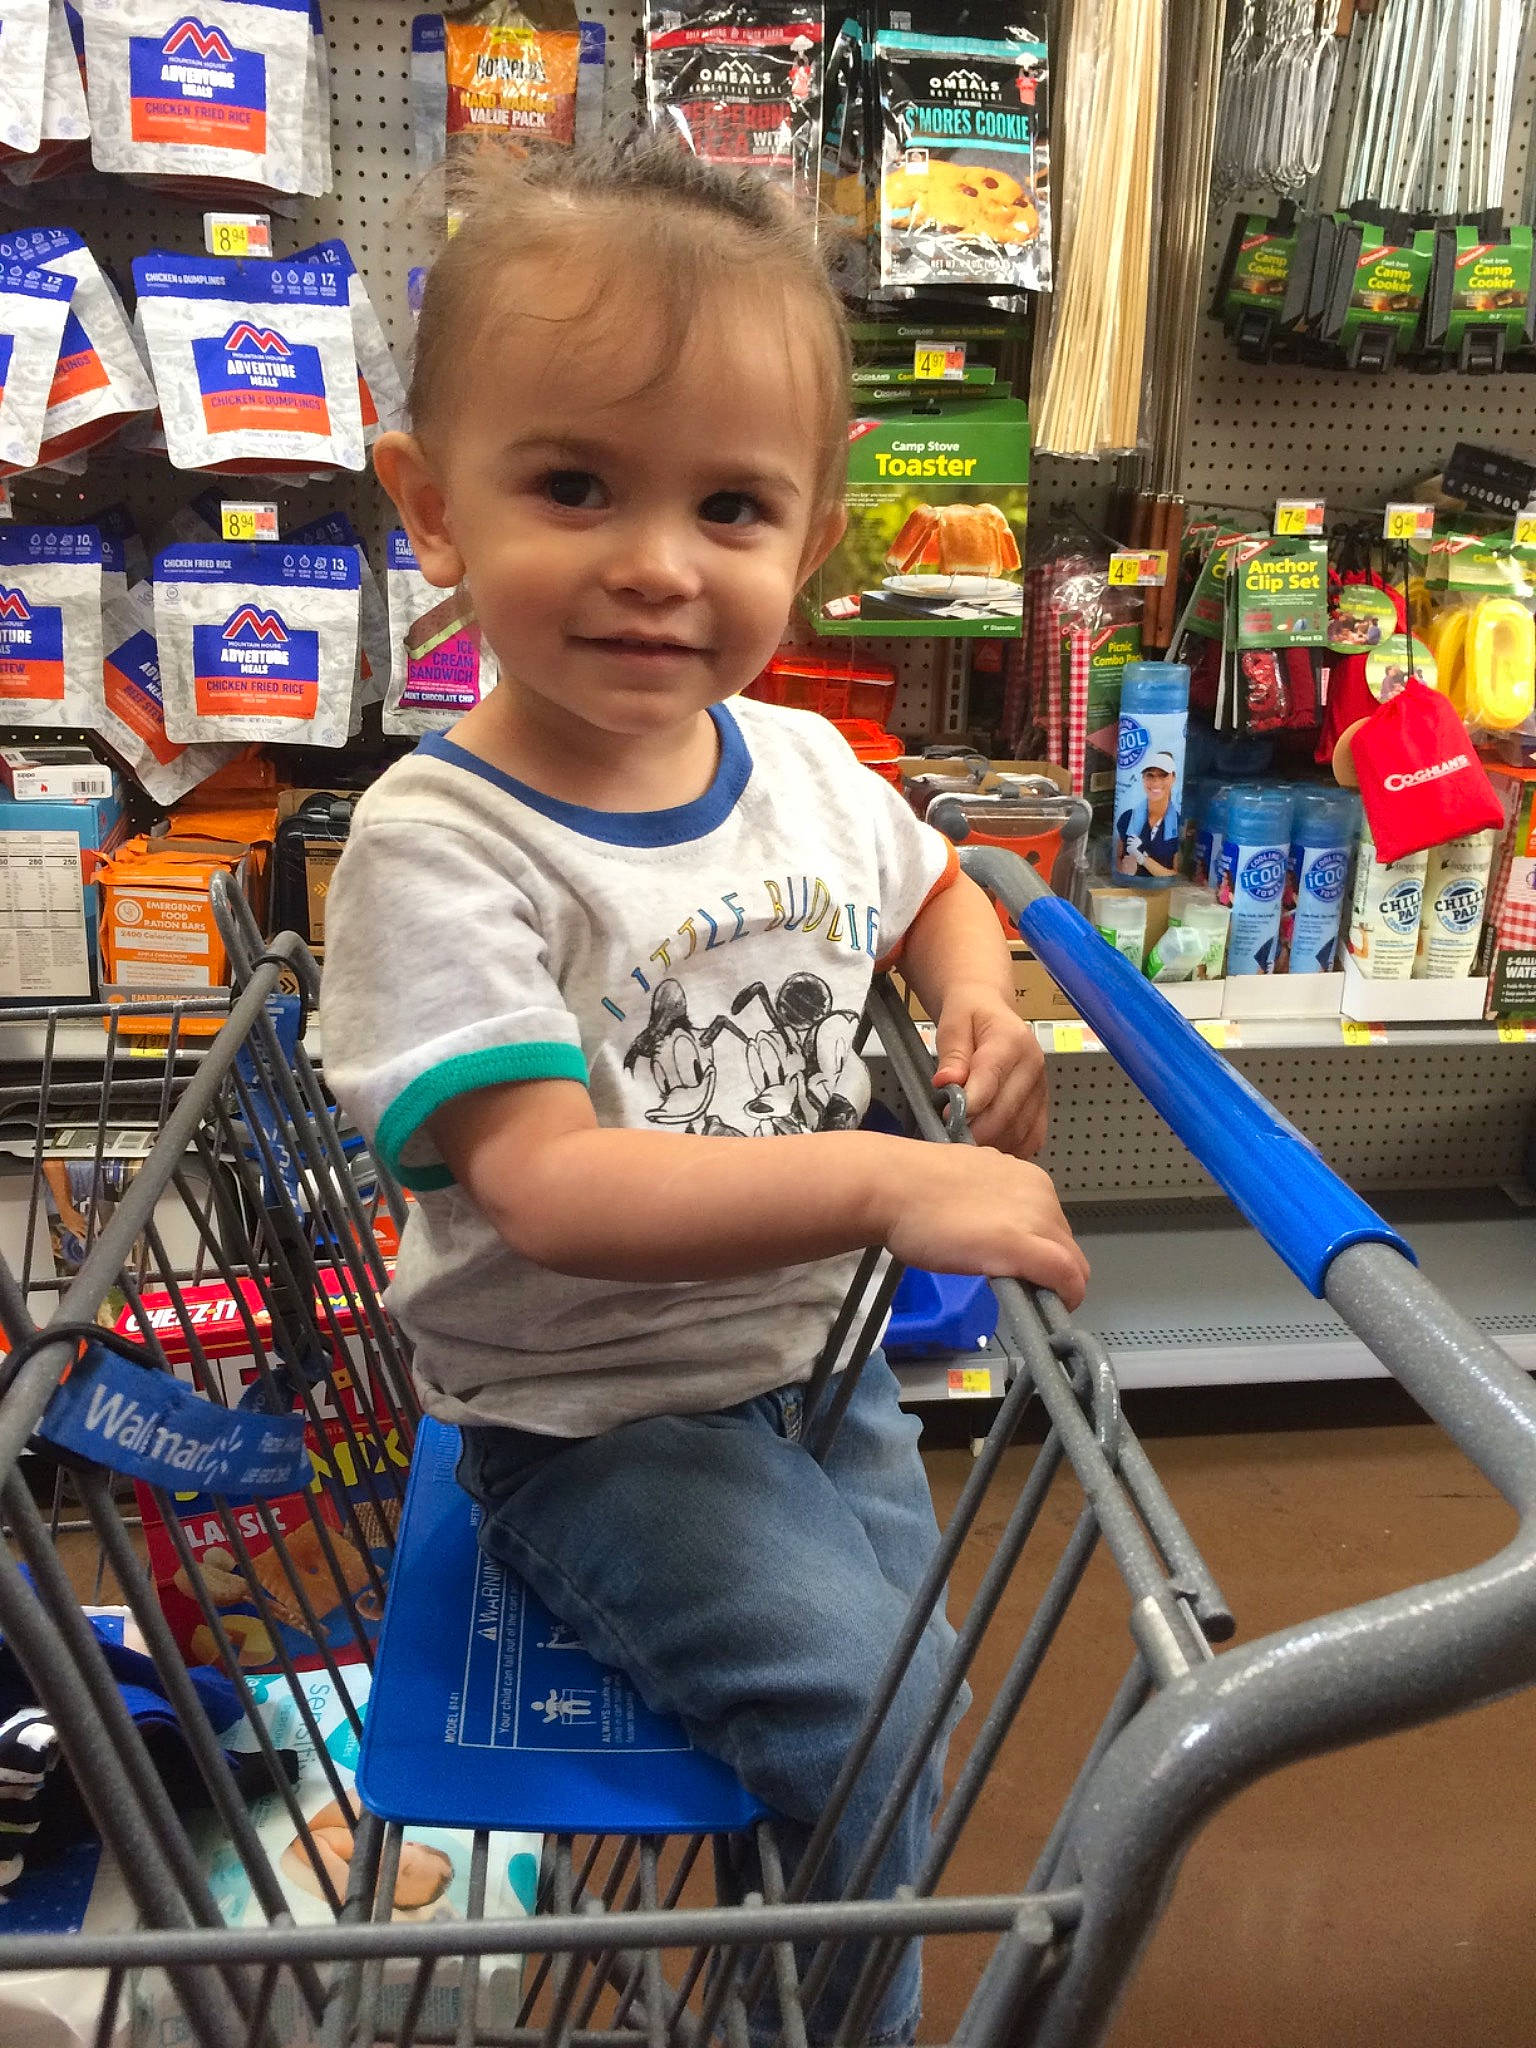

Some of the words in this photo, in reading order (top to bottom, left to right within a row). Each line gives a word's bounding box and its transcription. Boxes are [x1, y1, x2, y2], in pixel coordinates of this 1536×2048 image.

[161, 64, 235, 89] ADVENTURE
[700, 69, 771, 84] OMEALS
[182, 83, 213, 98] MEALS
[929, 77, 1000, 92] OMEALS
[145, 102, 191, 115] CHICKEN
[195, 105, 225, 120] FRIED
[228, 110, 252, 123] RICE
[470, 108, 510, 125] VALUE
[512, 110, 546, 128] PACK
[906, 107, 972, 135] S'MORES
[975, 111, 1030, 141] COOKIE
[1255, 251, 1288, 268] Camp
[1248, 261, 1289, 278] Cooker
[1375, 265, 1412, 281] Camp
[1474, 264, 1513, 278] Camp
[145, 272, 178, 283] CHICKEN
[183, 275, 226, 285] DUMPLINGS
[1368, 277, 1413, 293] Cooker
[1469, 276, 1516, 289] Cooker
[227, 359, 296, 379] ADVENTURE
[250, 375, 279, 388] MEALS
[211, 395, 255, 408] CHICKEN
[265, 396, 321, 410] DUMPLINGS
[891, 441, 925, 453] Camp
[927, 441, 960, 452] Stove
[875, 453, 977, 477] Toaster
[163, 559, 193, 568] CHICKEN
[195, 559, 215, 568] FRIED
[216, 560, 232, 569] RICE
[1248, 557, 1318, 574] Anchor
[1245, 574, 1284, 593] Clip
[1288, 574, 1320, 590] Set
[457, 641, 475, 655] ICE
[1108, 642, 1133, 653] Picnic
[221, 649, 289, 666] ADVENTURE
[432, 653, 475, 669] CREAM
[1093, 655, 1124, 666] Combo
[241, 665, 269, 675] MEALS
[410, 665, 474, 684] SANDWICH
[207, 680, 247, 691] CHICKEN
[252, 682, 279, 693] FRIED
[282, 683, 304, 694] RICE
[404, 691, 420, 701] MINT
[421, 692, 457, 703] CHOCOLATE
[459, 694, 475, 703] CHIP
[146, 902, 203, 912] EMERGENCY
[1454, 904, 1478, 920] PAD
[161, 912, 189, 921] FOOD
[144, 919, 180, 929] RATION
[182, 922, 206, 931] BARS
[1505, 966, 1536, 979] WATE
[85, 1384, 208, 1474] Walmart
[479, 1553, 504, 1623] WARNIN
[506, 1613, 517, 1628] the
[505, 1628, 516, 1637] of
[505, 1638, 516, 1653] out
[503, 1654, 515, 1669] fall
[503, 1670, 514, 1687] can
[501, 1689, 513, 1711] child
[444, 1712, 458, 1744] MODEL
[500, 1712, 512, 1734] Your
[602, 1709, 613, 1744] ALWAYS
